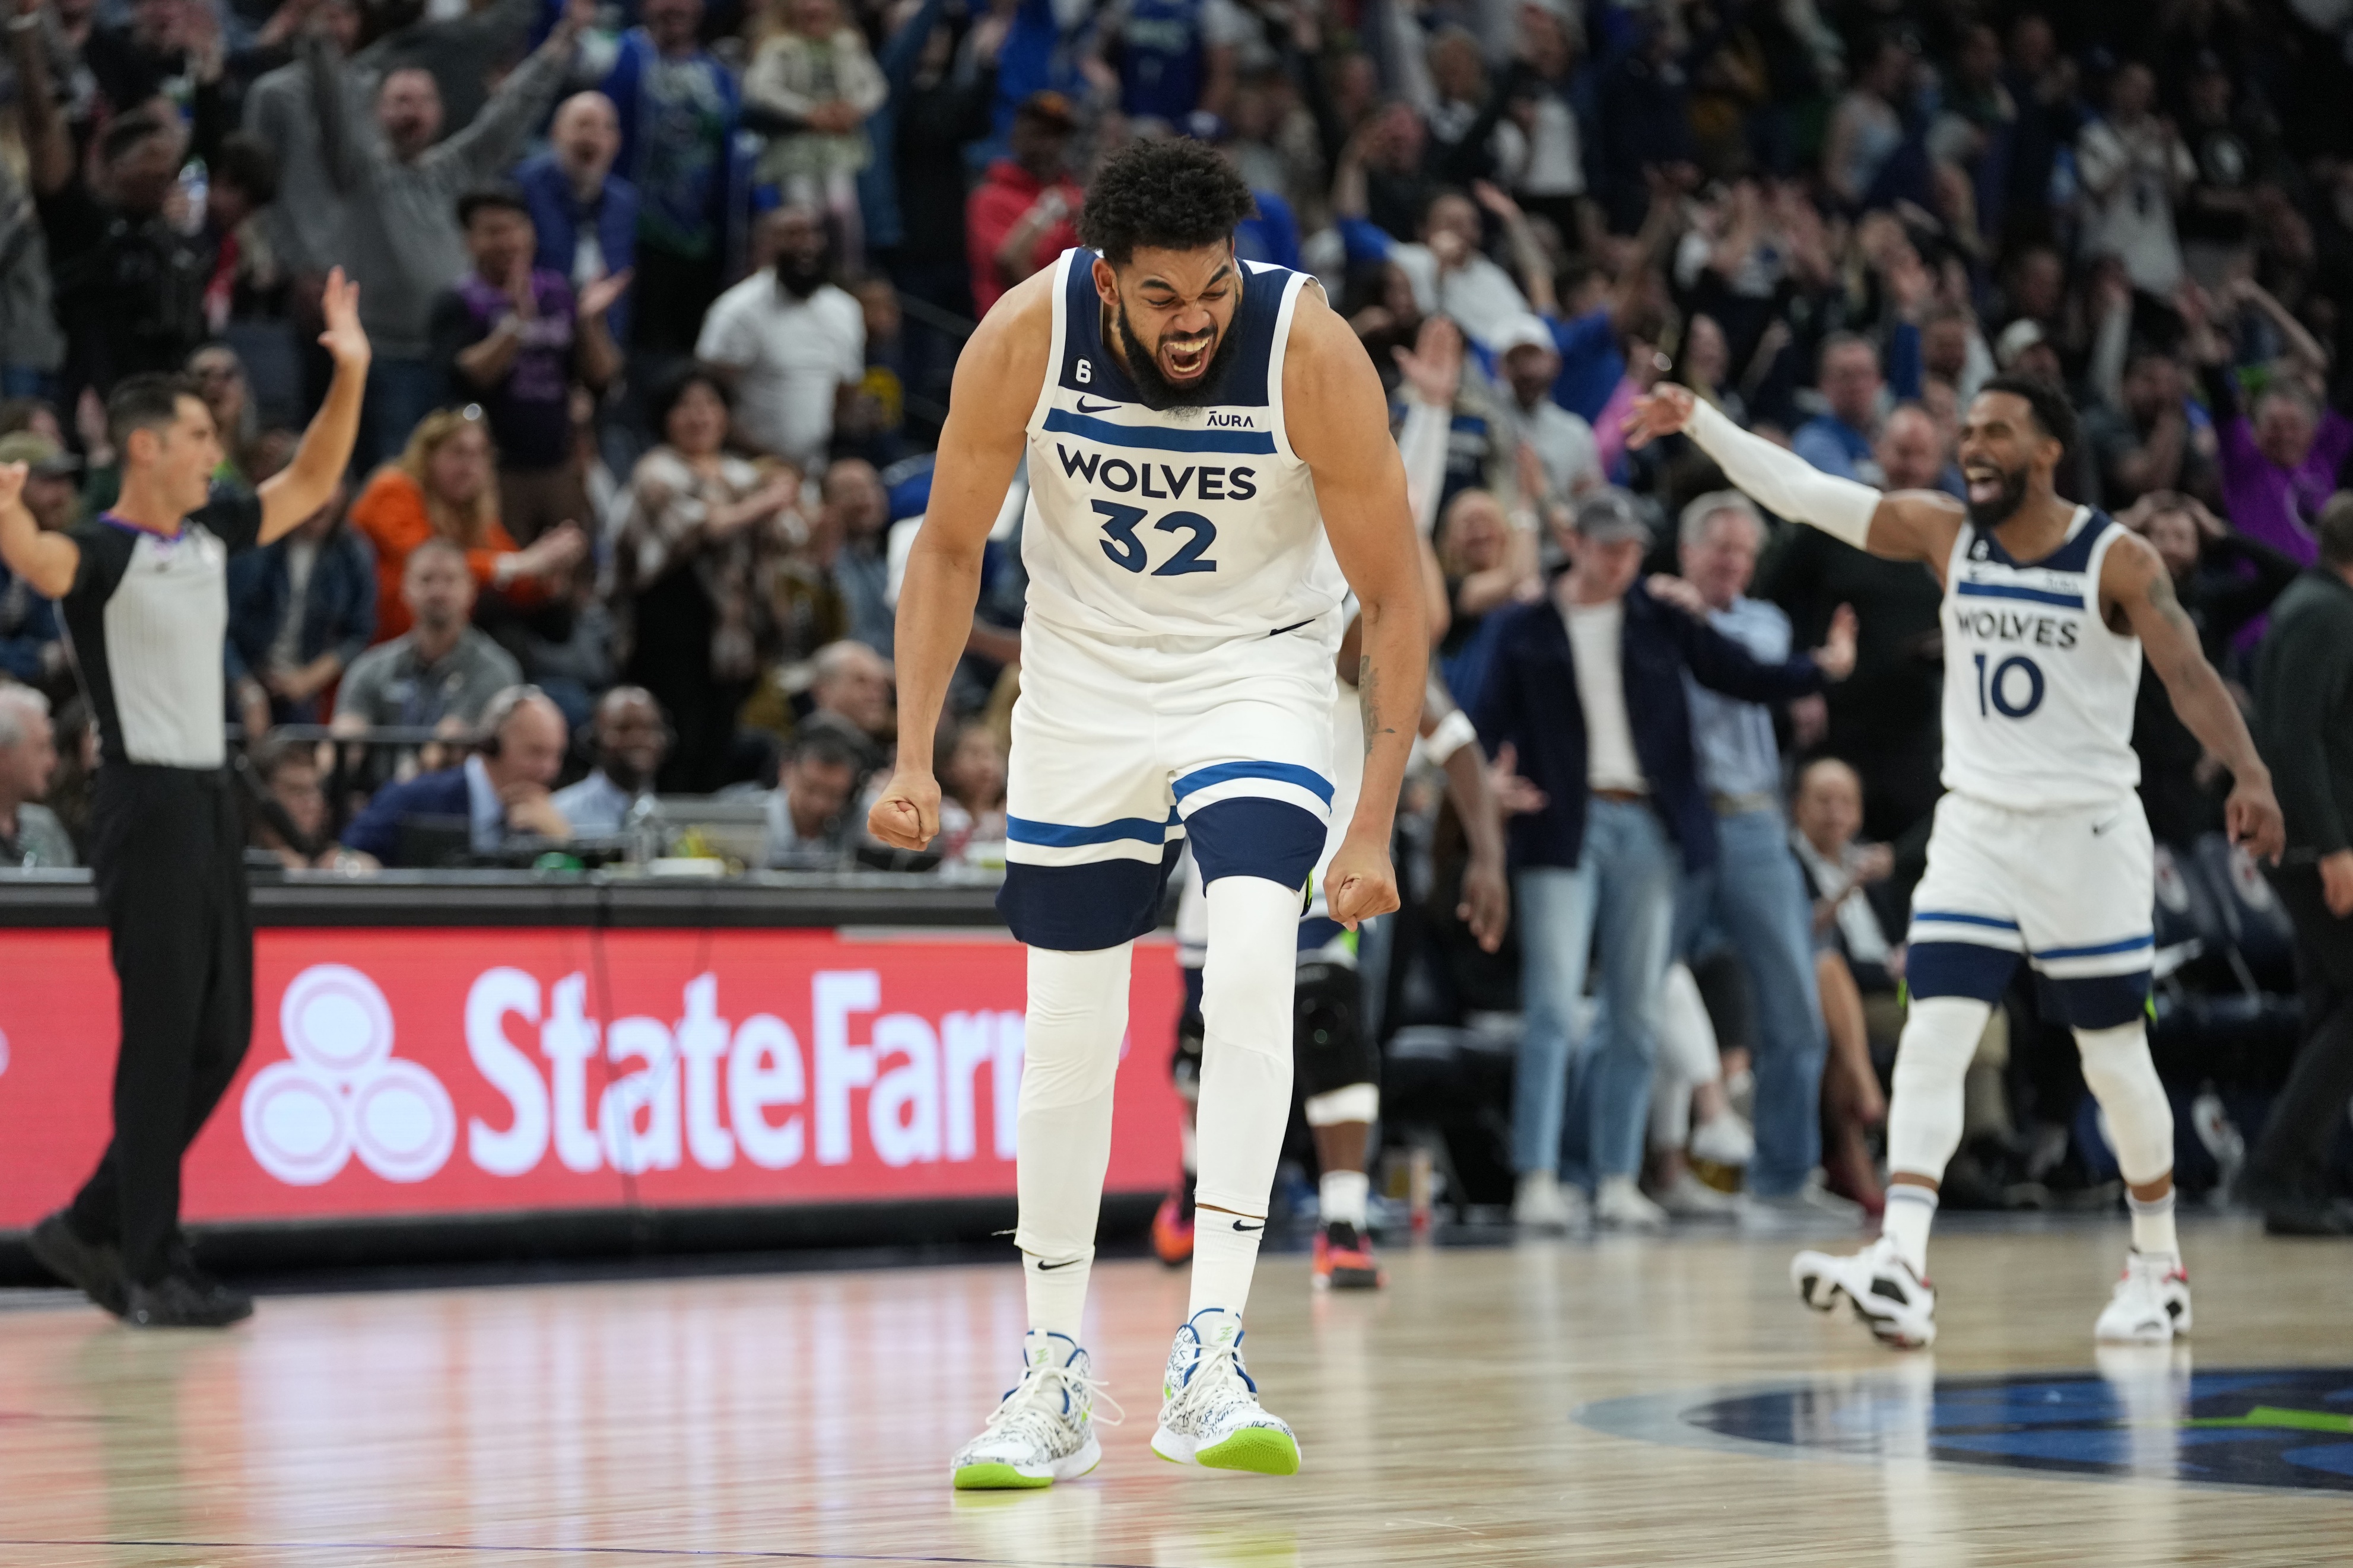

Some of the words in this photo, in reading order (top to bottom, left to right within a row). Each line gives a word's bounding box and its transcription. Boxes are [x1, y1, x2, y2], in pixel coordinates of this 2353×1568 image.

[1075, 358, 1091, 383] 6
[1056, 443, 1257, 501] WOLVES
[1090, 498, 1217, 577] 32
[1956, 608, 2078, 648] WOLVES
[1974, 653, 2045, 720] 10
